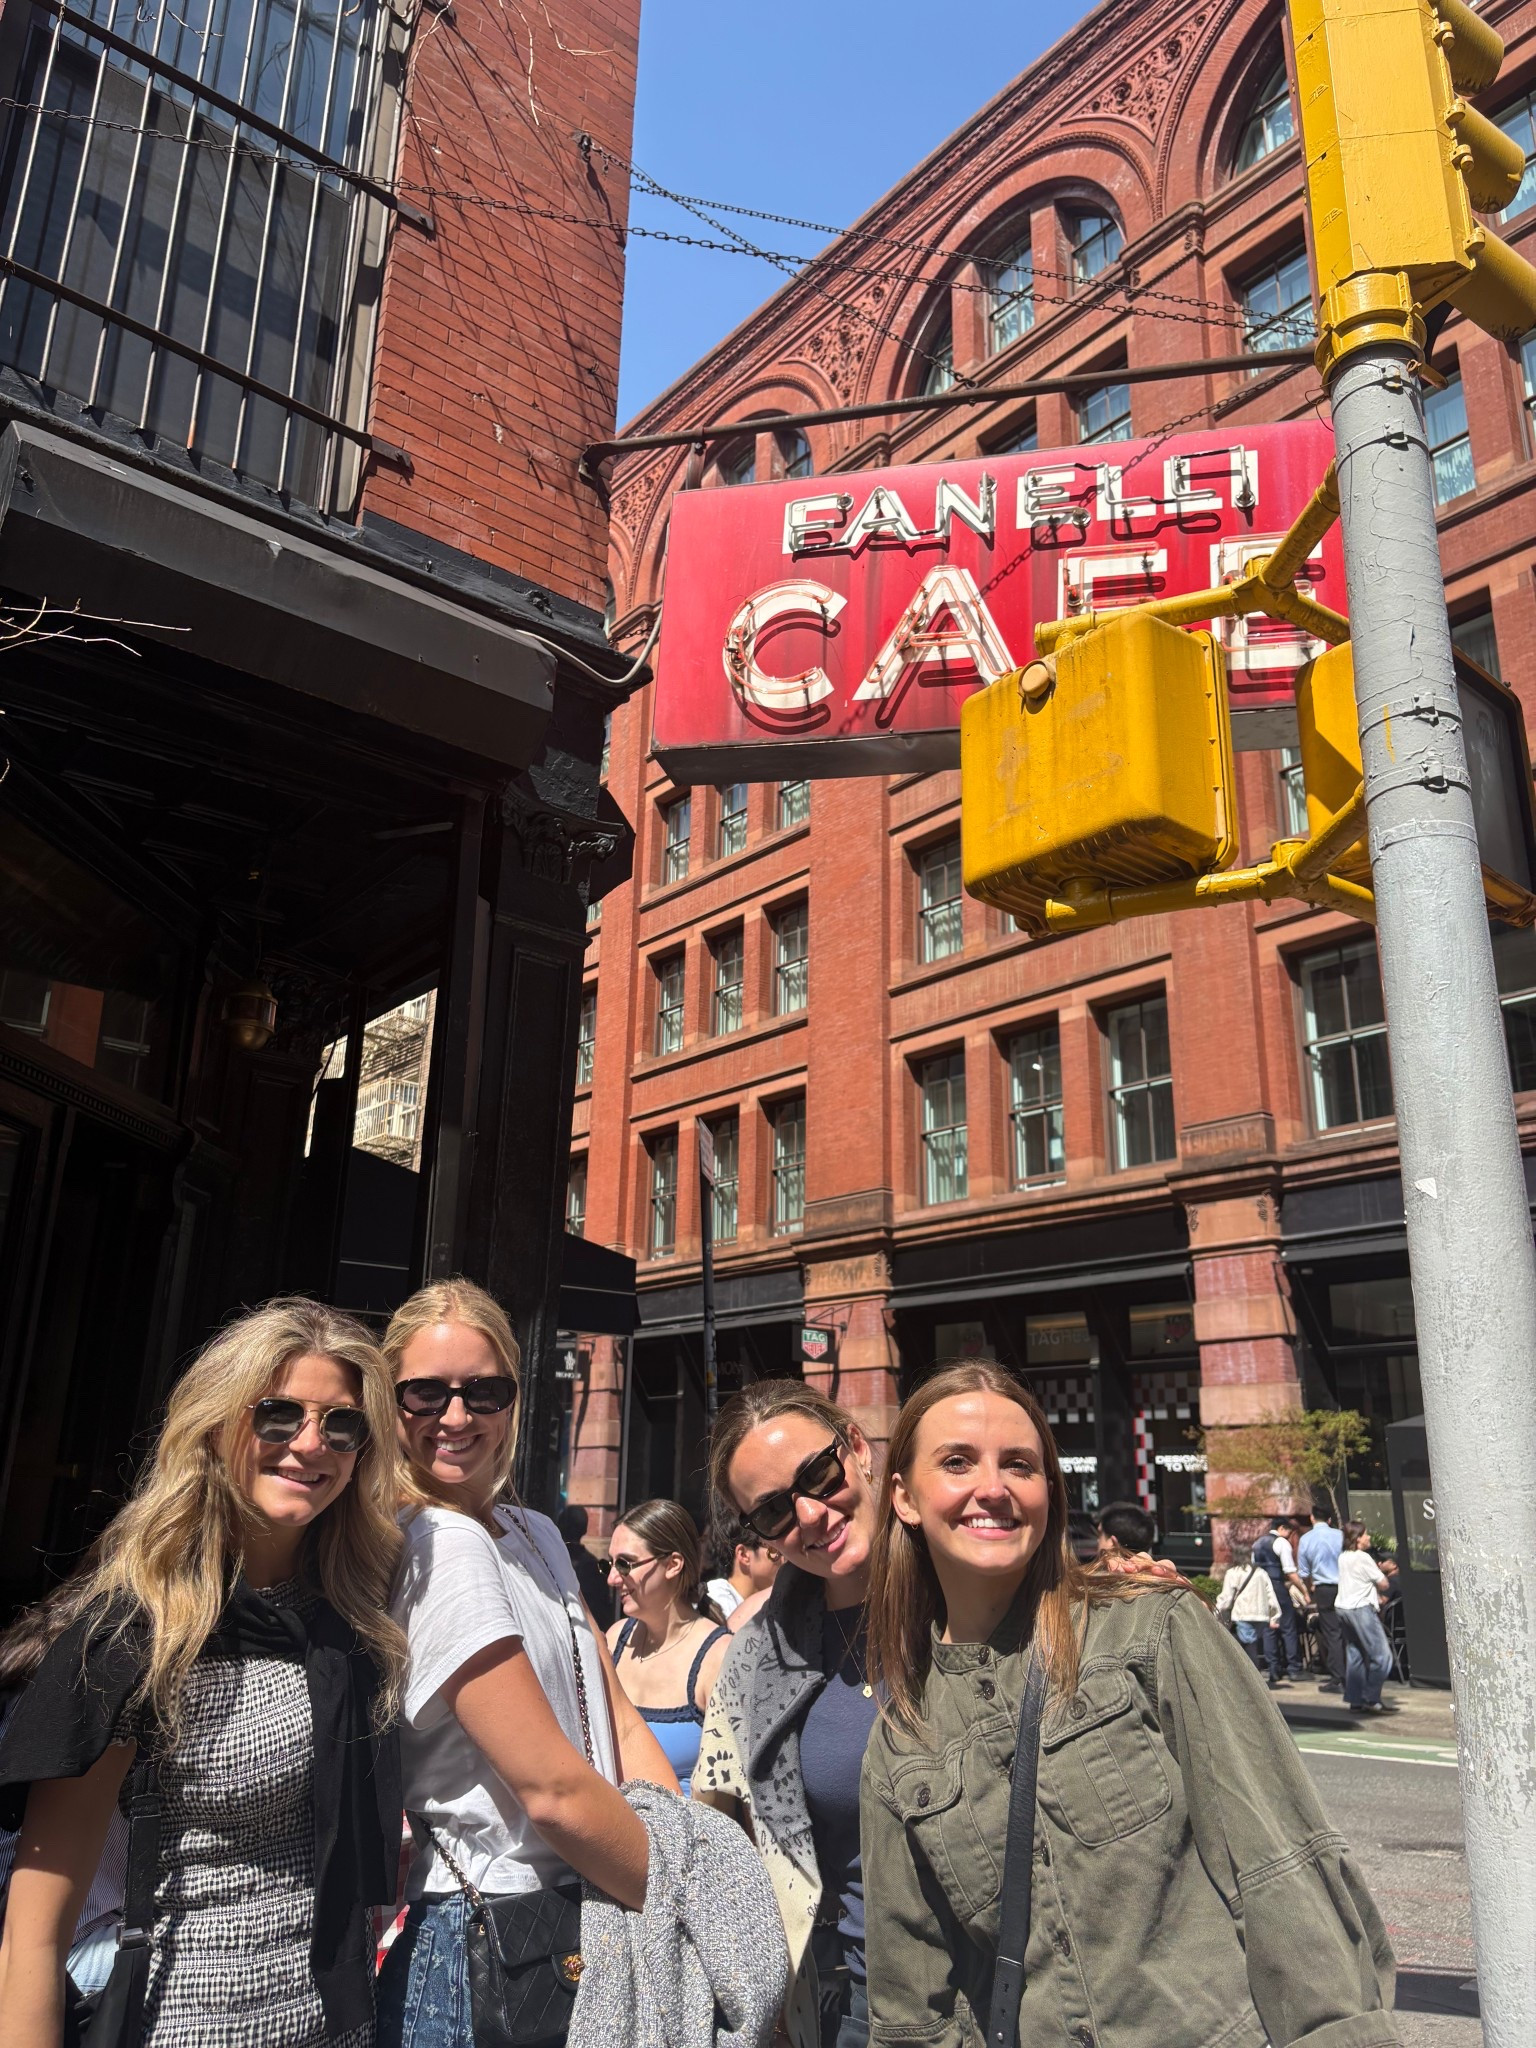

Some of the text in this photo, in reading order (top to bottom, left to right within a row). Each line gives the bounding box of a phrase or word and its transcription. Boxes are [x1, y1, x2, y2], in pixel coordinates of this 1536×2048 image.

[782, 447, 1258, 555] FANELLI
[722, 536, 1328, 711] CAFE
[806, 1331, 826, 1342] TAG
